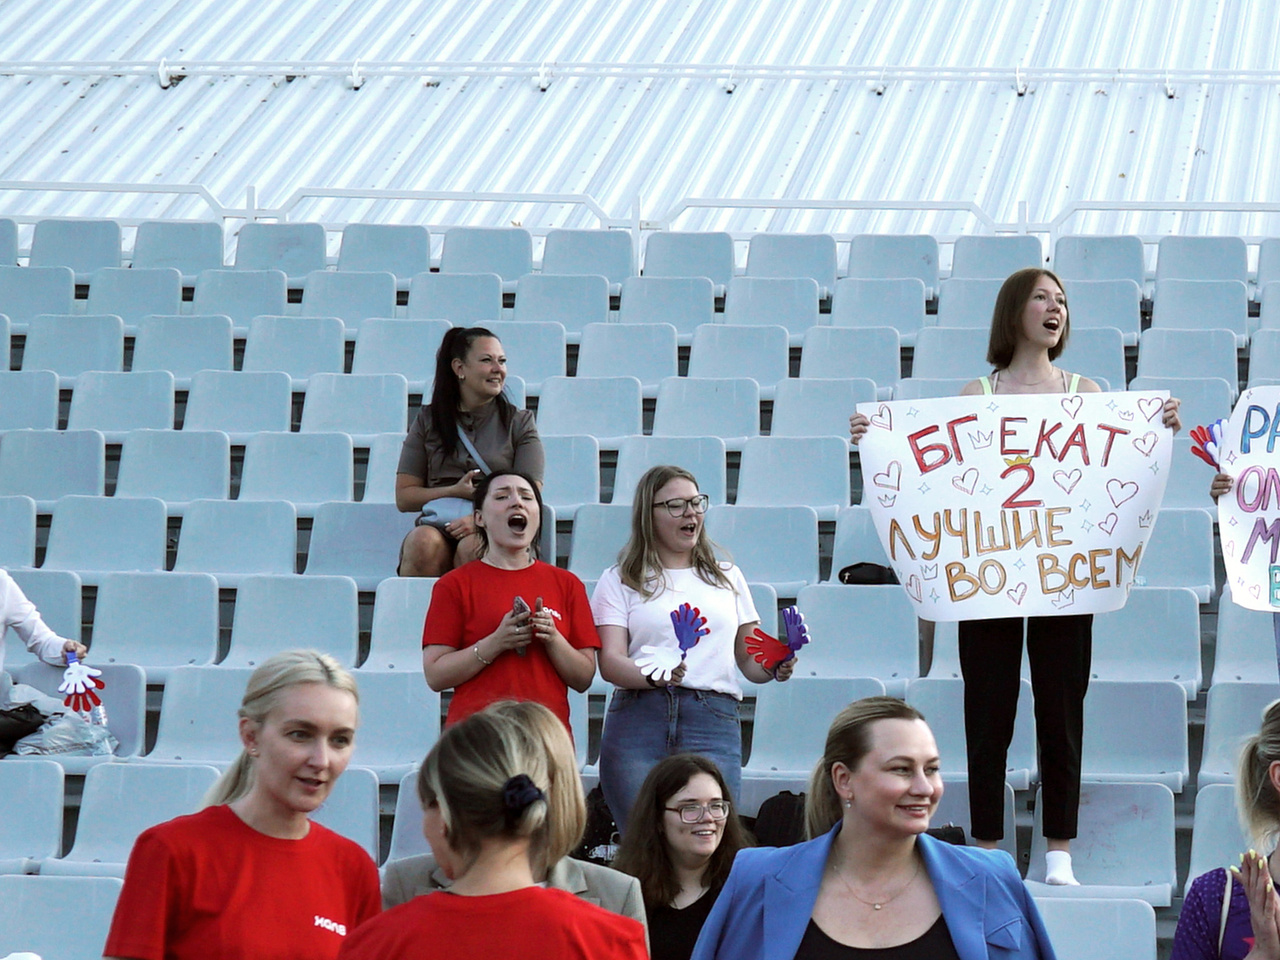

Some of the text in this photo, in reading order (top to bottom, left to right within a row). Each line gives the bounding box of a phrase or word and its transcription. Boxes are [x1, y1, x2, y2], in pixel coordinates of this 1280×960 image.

[907, 413, 1131, 476] БГ ЕКАТ
[1000, 463, 1045, 509] 2
[888, 507, 1074, 561] ЛУЧШИЕ
[944, 541, 1143, 603] ВО ВСЕМ
